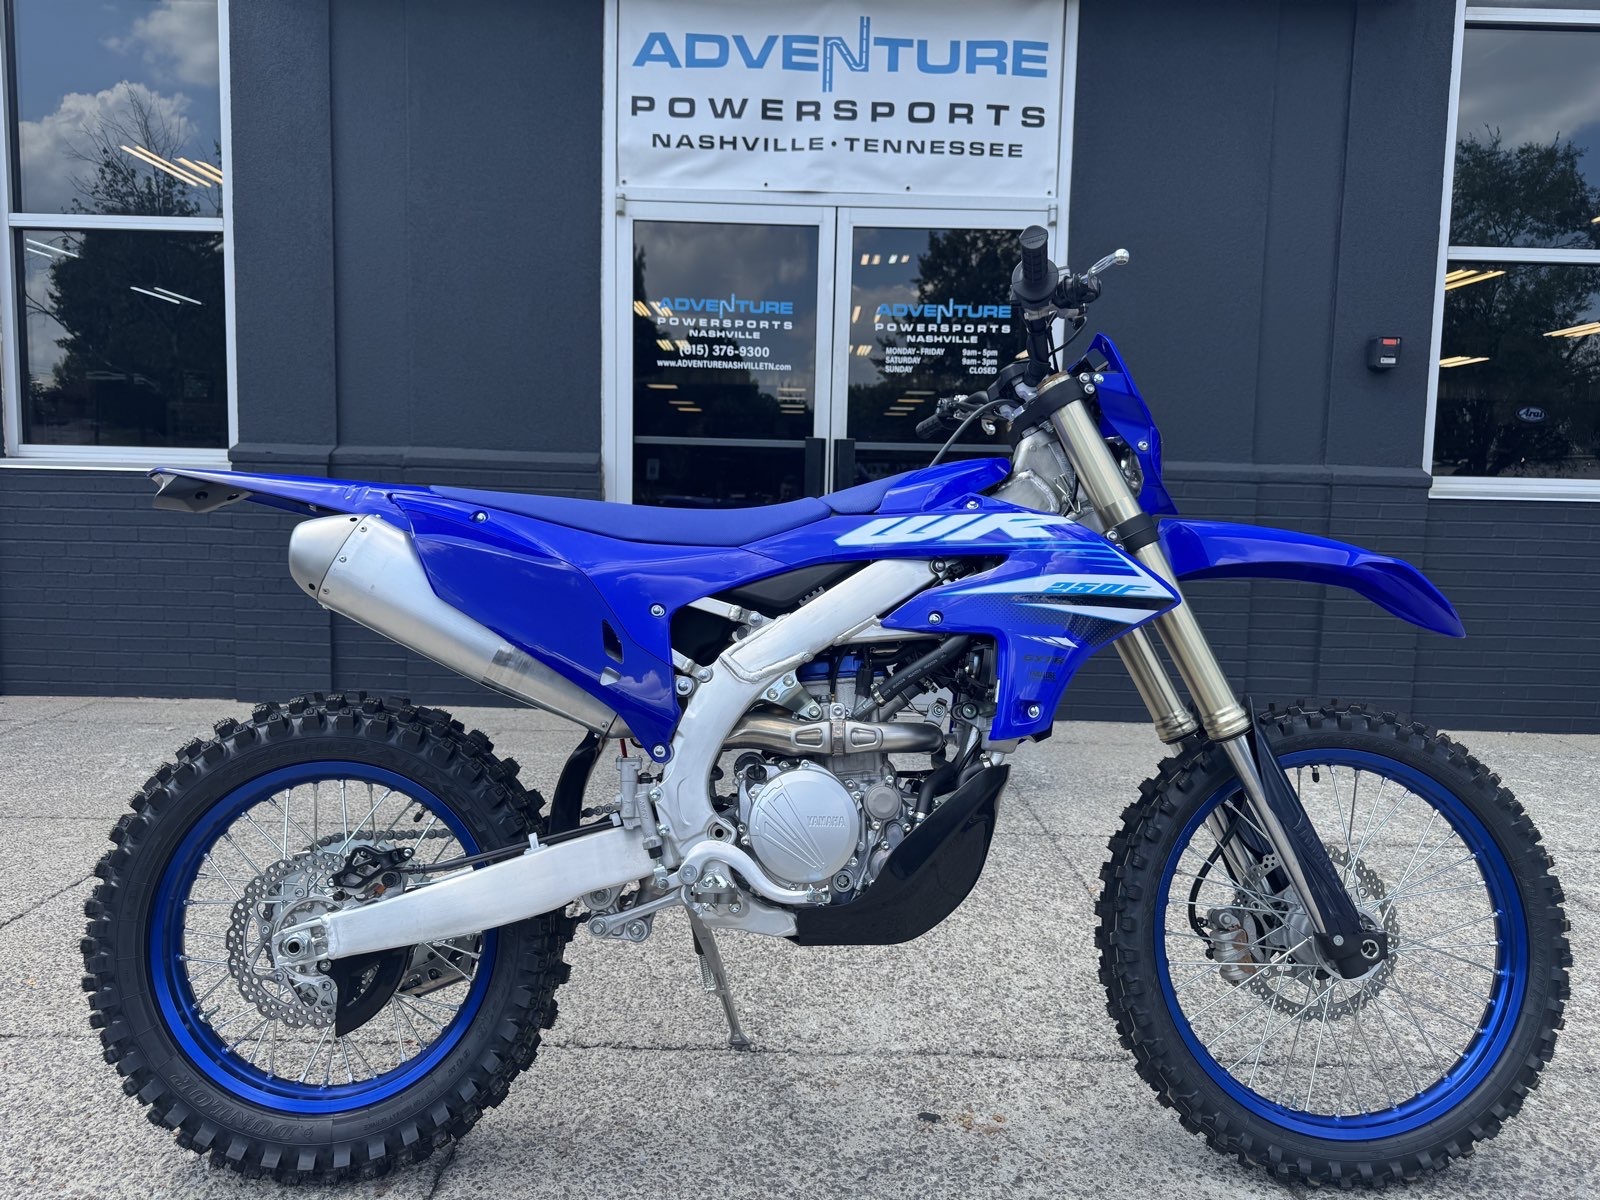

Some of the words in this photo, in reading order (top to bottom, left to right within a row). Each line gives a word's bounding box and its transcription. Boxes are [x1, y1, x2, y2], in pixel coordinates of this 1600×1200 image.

[632, 16, 1049, 93] ADVENTURE
[631, 95, 1046, 128] POWERSPORTS
[652, 133, 825, 152] NASHVILLE
[844, 136, 1023, 158] TENNESSEE
[659, 293, 793, 318] ADVENTURE
[878, 298, 1012, 323] ADVENTURE
[657, 317, 793, 329] POWERSPORTS
[875, 323, 1011, 334] POWERSPORTS
[689, 329, 761, 339] NASHVILLE
[906, 335, 978, 344] NASHVILLE
[712, 345, 770, 358] 376-9300
[657, 359, 791, 370] www.ADVENTURENASHVILLETN.com
[885, 356, 921, 365] SATURDAY
[884, 365, 914, 374] SUNDAY
[968, 366, 998, 375] CLOSED
[833, 513, 1078, 546] WR
[1045, 581, 1152, 596] 250F
[806, 815, 846, 828] YAMAHA
[169, 1074, 299, 1140] DUNLOP
